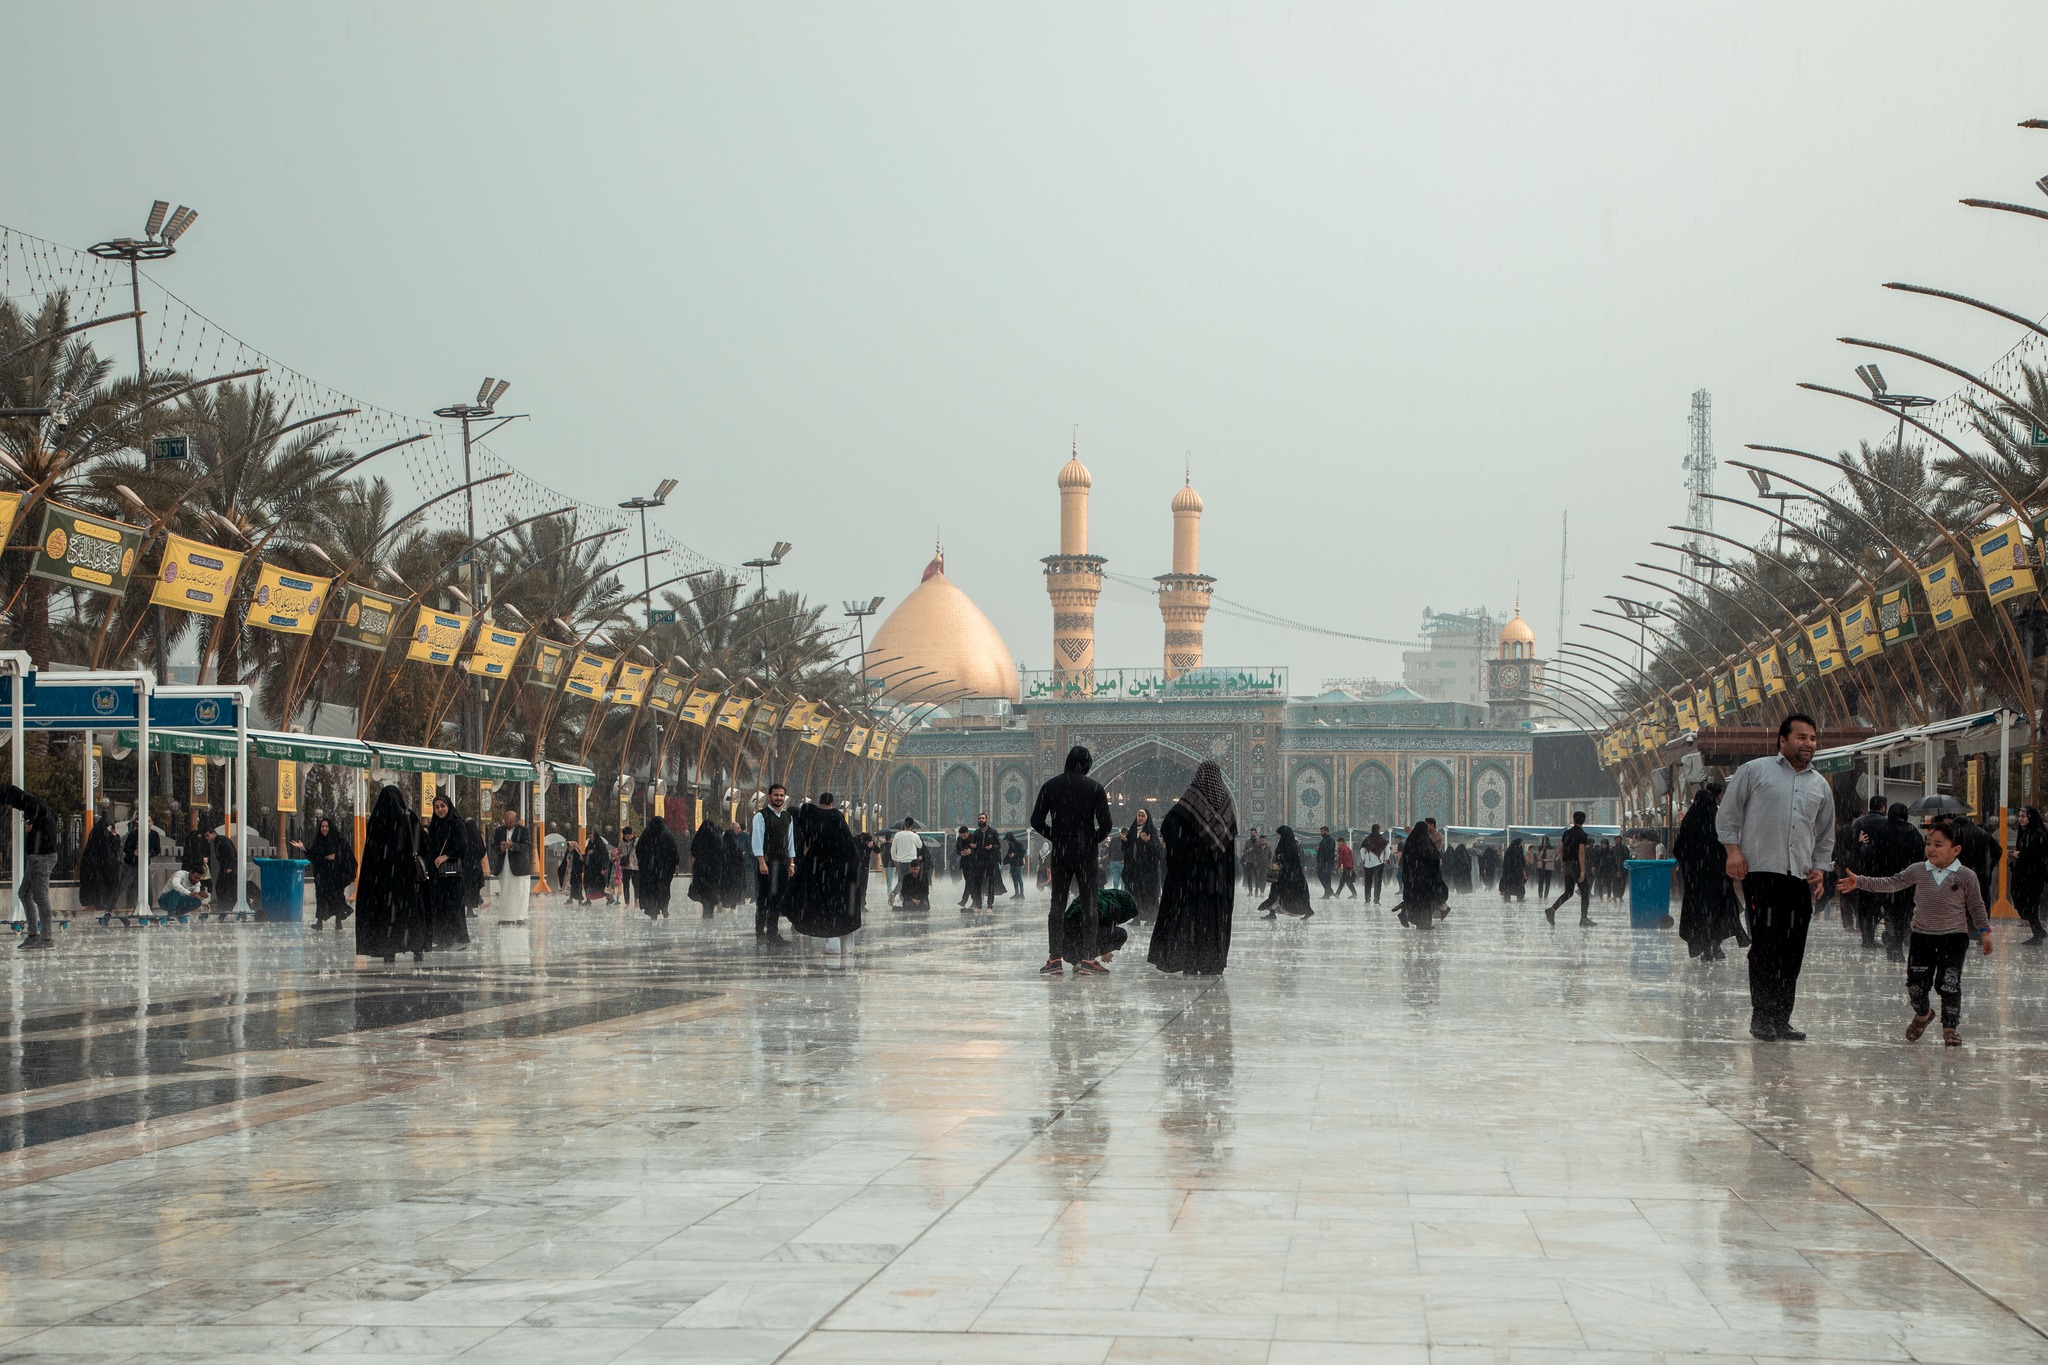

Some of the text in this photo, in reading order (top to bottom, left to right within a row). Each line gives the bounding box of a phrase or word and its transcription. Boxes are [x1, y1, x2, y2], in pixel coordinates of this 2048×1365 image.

[157, 443, 169, 456] 63
[1175, 674, 1220, 694] عليك
[1226, 672, 1281, 693] السلام
